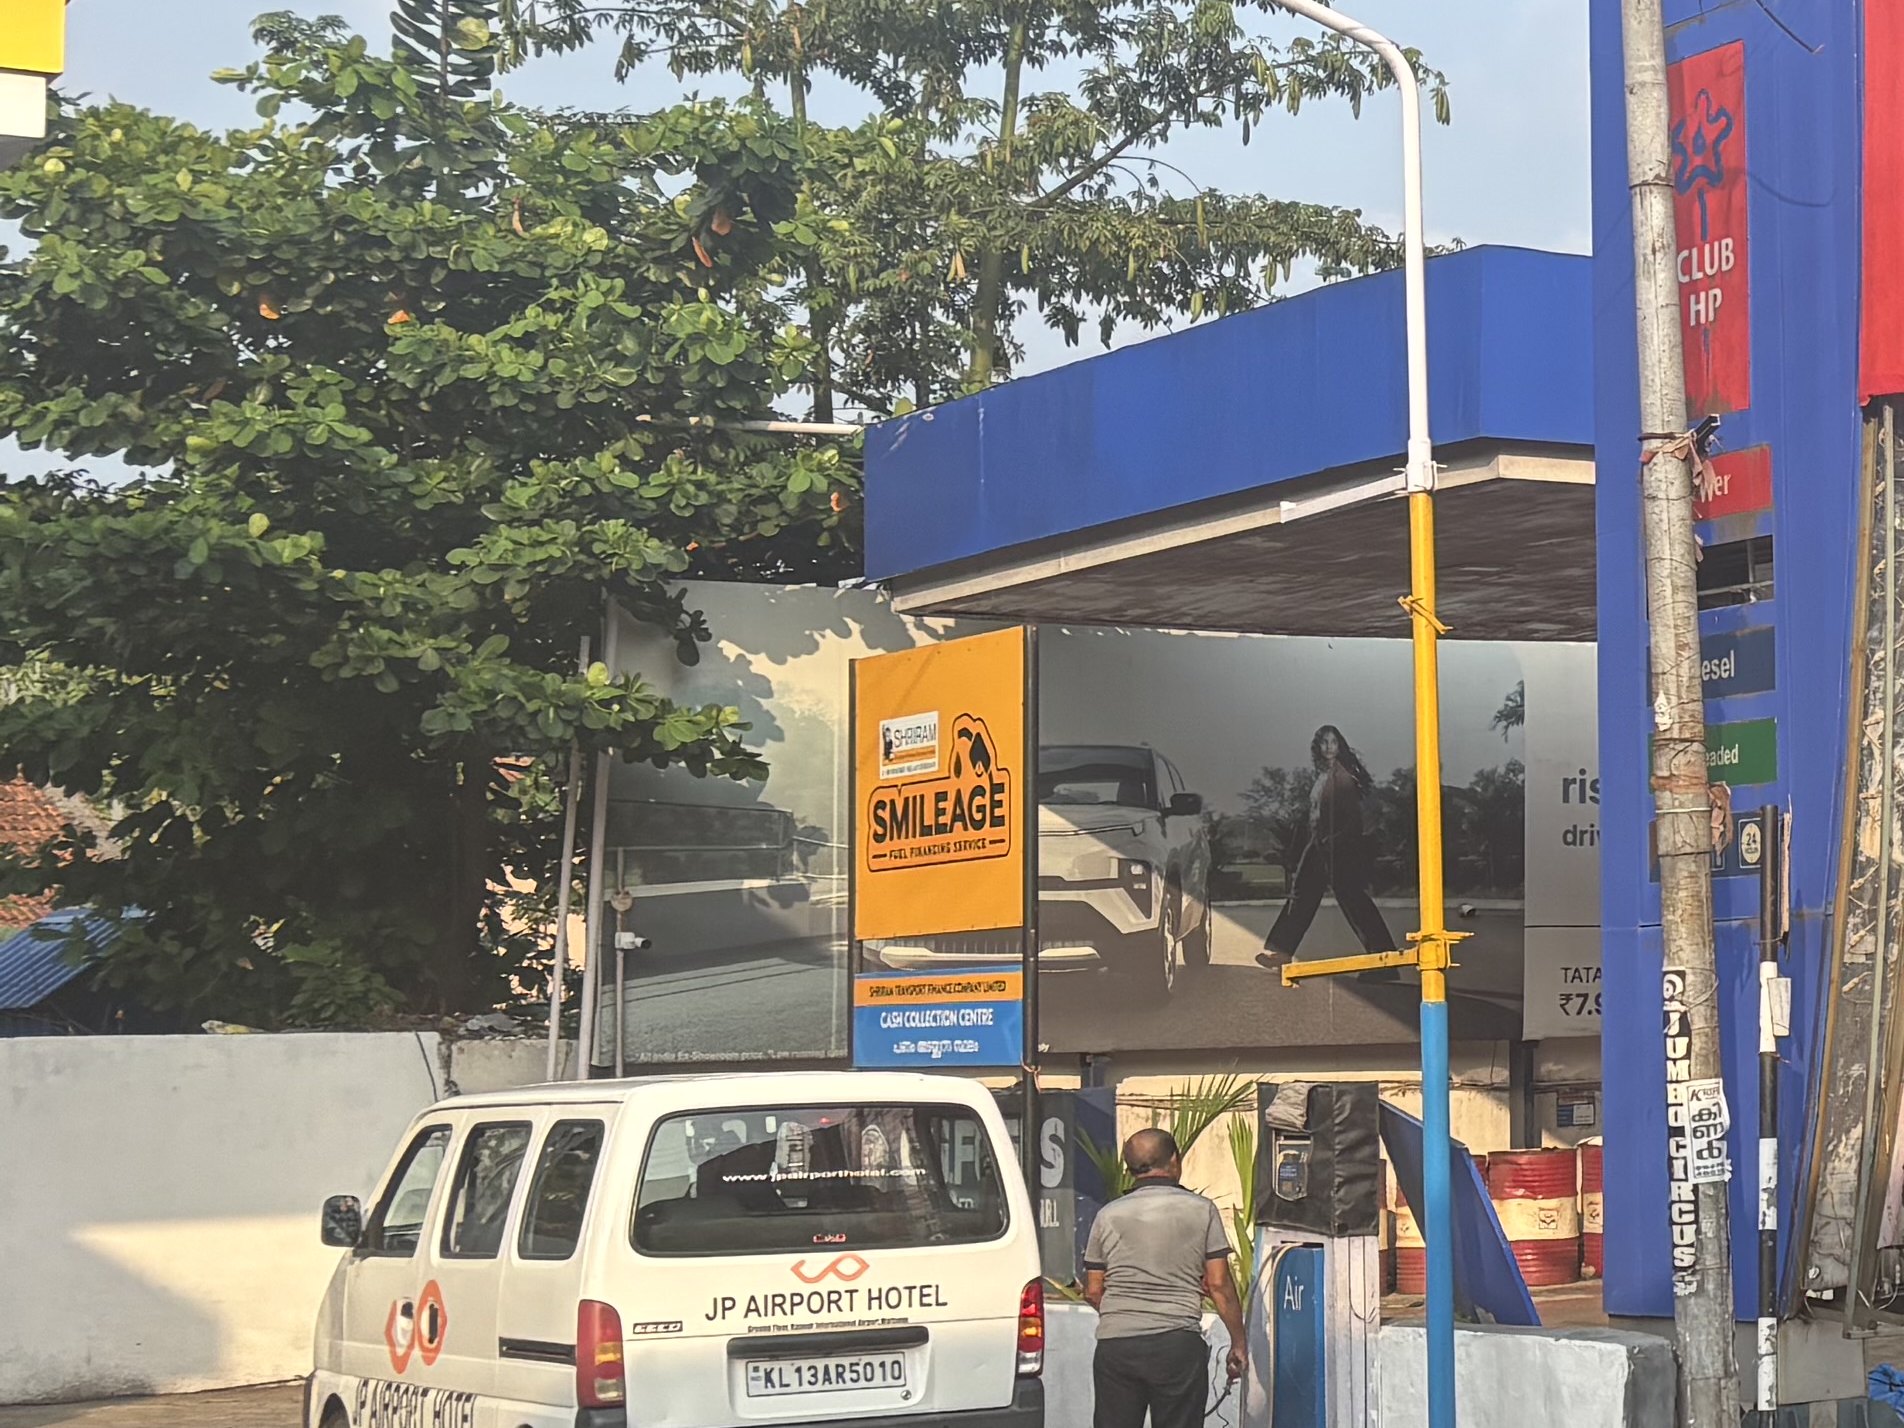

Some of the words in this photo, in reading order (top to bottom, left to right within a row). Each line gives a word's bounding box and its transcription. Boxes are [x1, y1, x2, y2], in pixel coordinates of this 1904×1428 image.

[1675, 237, 1735, 283] CLUB
[1689, 289, 1722, 327] HP
[873, 777, 1005, 844] SMILEAGE
[889, 849, 908, 860] FUEL
[910, 843, 950, 858] FINANCING
[953, 838, 987, 852] SERVICE
[1745, 832, 1757, 845] 24
[880, 1012, 903, 1029] CASH
[904, 1009, 957, 1028] COLLECTION
[958, 1008, 994, 1026] CENTRE
[1669, 1137, 1697, 1268] CIRCUS
[705, 1296, 736, 1322] JP
[743, 1288, 859, 1319] AIRPORT
[867, 1283, 948, 1311] HOTEL
[1283, 1275, 1305, 1311] Air
[763, 1359, 901, 1389] KL13AR5010
[353, 1378, 369, 1427] JP
